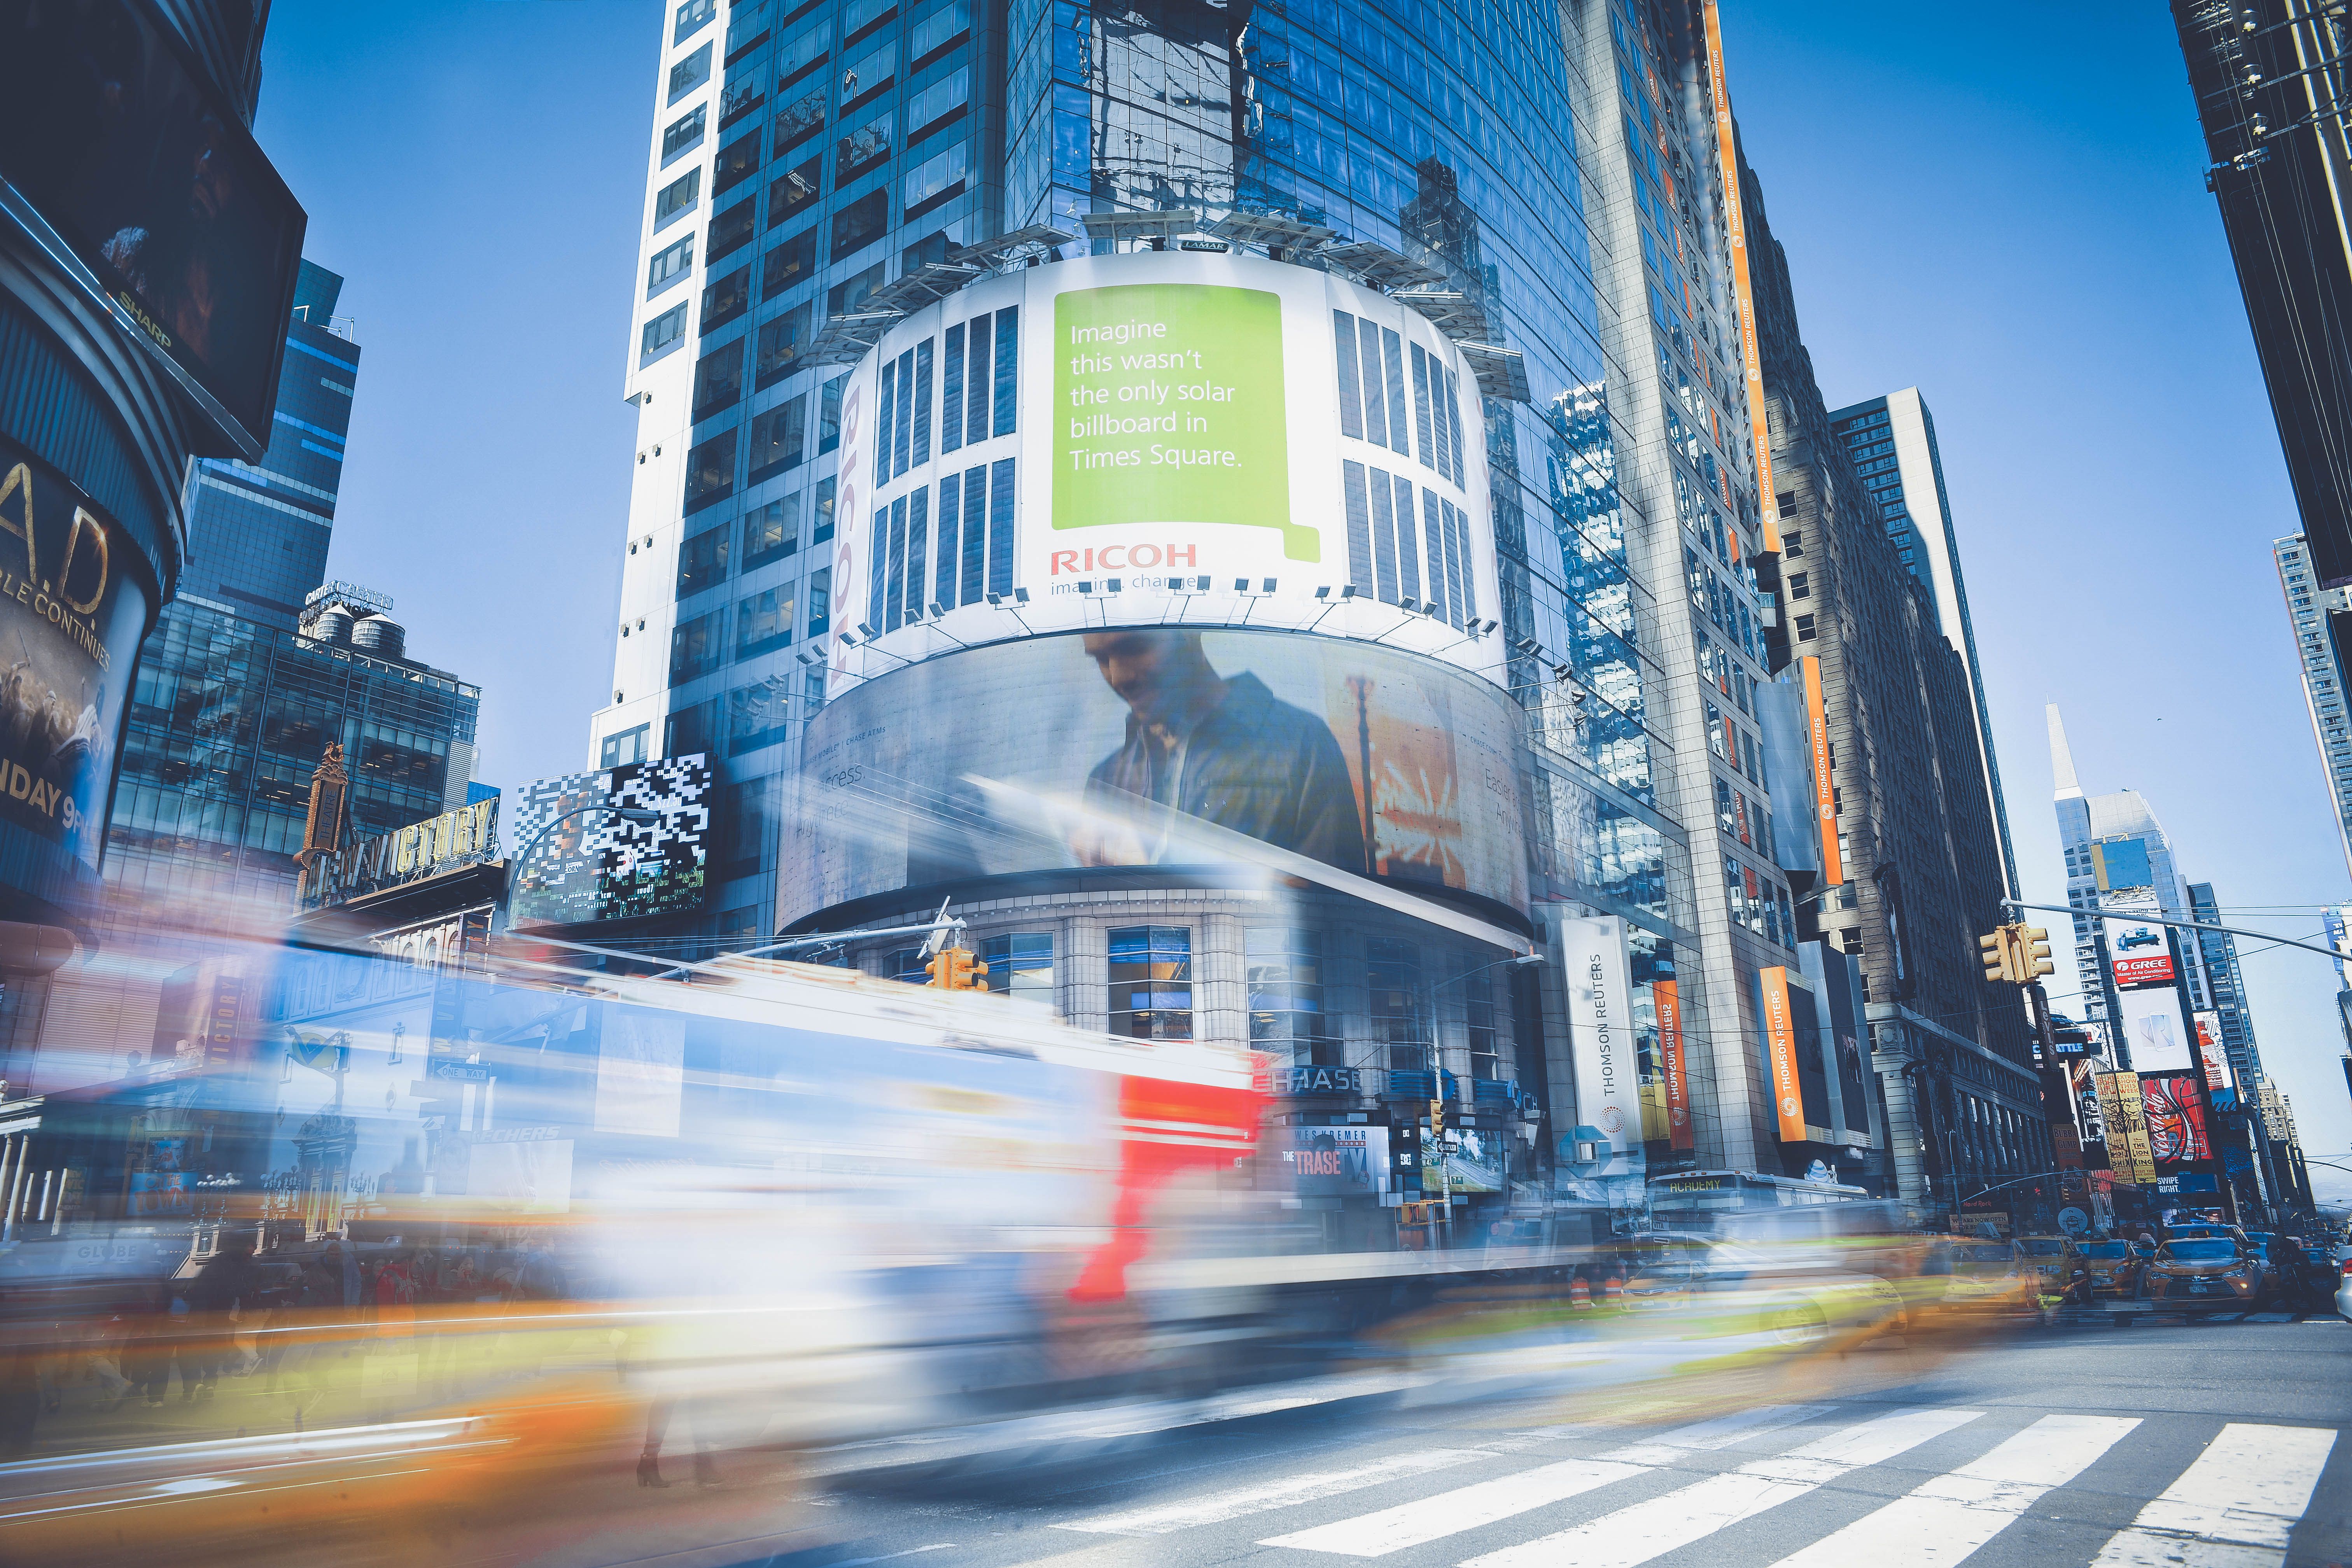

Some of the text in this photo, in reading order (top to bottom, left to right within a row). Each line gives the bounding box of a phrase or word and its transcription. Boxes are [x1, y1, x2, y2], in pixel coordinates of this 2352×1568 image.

[1712, 50, 1724, 108] THOMSON REUTERS
[1727, 170, 1739, 231] THOMSON REUTERS
[119, 291, 172, 348] SHARP
[1071, 319, 1166, 346] Imagine
[1742, 298, 1755, 364] THOMSON REUTERS
[1071, 350, 1202, 375] this wasn't
[1071, 380, 1235, 406] the only solar
[1070, 411, 1207, 438] billboard in
[1069, 444, 1242, 470] Times Square.
[1757, 435, 1771, 506] THOMSON REUTERS
[831, 385, 860, 688] RICOH
[1051, 544, 1196, 575] RICOH
[1052, 577, 1124, 595] imain.
[0, 569, 110, 672] LE CONTINUES
[846, 732, 865, 746] CHASE
[868, 726, 886, 737] ATMs
[1814, 717, 1829, 799] THOMSON REUTERS
[1486, 768, 1510, 802] Easier
[319, 789, 337, 840] THEATRE
[367, 798, 496, 882] VICTORY
[2130, 959, 2166, 970] GREE
[210, 981, 238, 1065] VICTORY
[1590, 954, 1615, 1097] THOMSON REUTERS
[1771, 990, 1791, 1092] THOMSON REUTERS
[442, 1068, 483, 1079] ONE WAY
[1295, 1130, 1316, 1140] WES
[2054, 1128, 2077, 1138] BUBBA
[2058, 1139, 2077, 1149] GUMP
[1282, 1151, 1295, 1162] THE
[2132, 1149, 2149, 1157] LION
[2133, 1158, 2153, 1167] KING
[135, 1185, 189, 1212] TOWN
[1670, 1180, 1720, 1193] ACADEMY
[2159, 1185, 2180, 1193] RIGHT.
[78, 1245, 136, 1259] GLOBE
